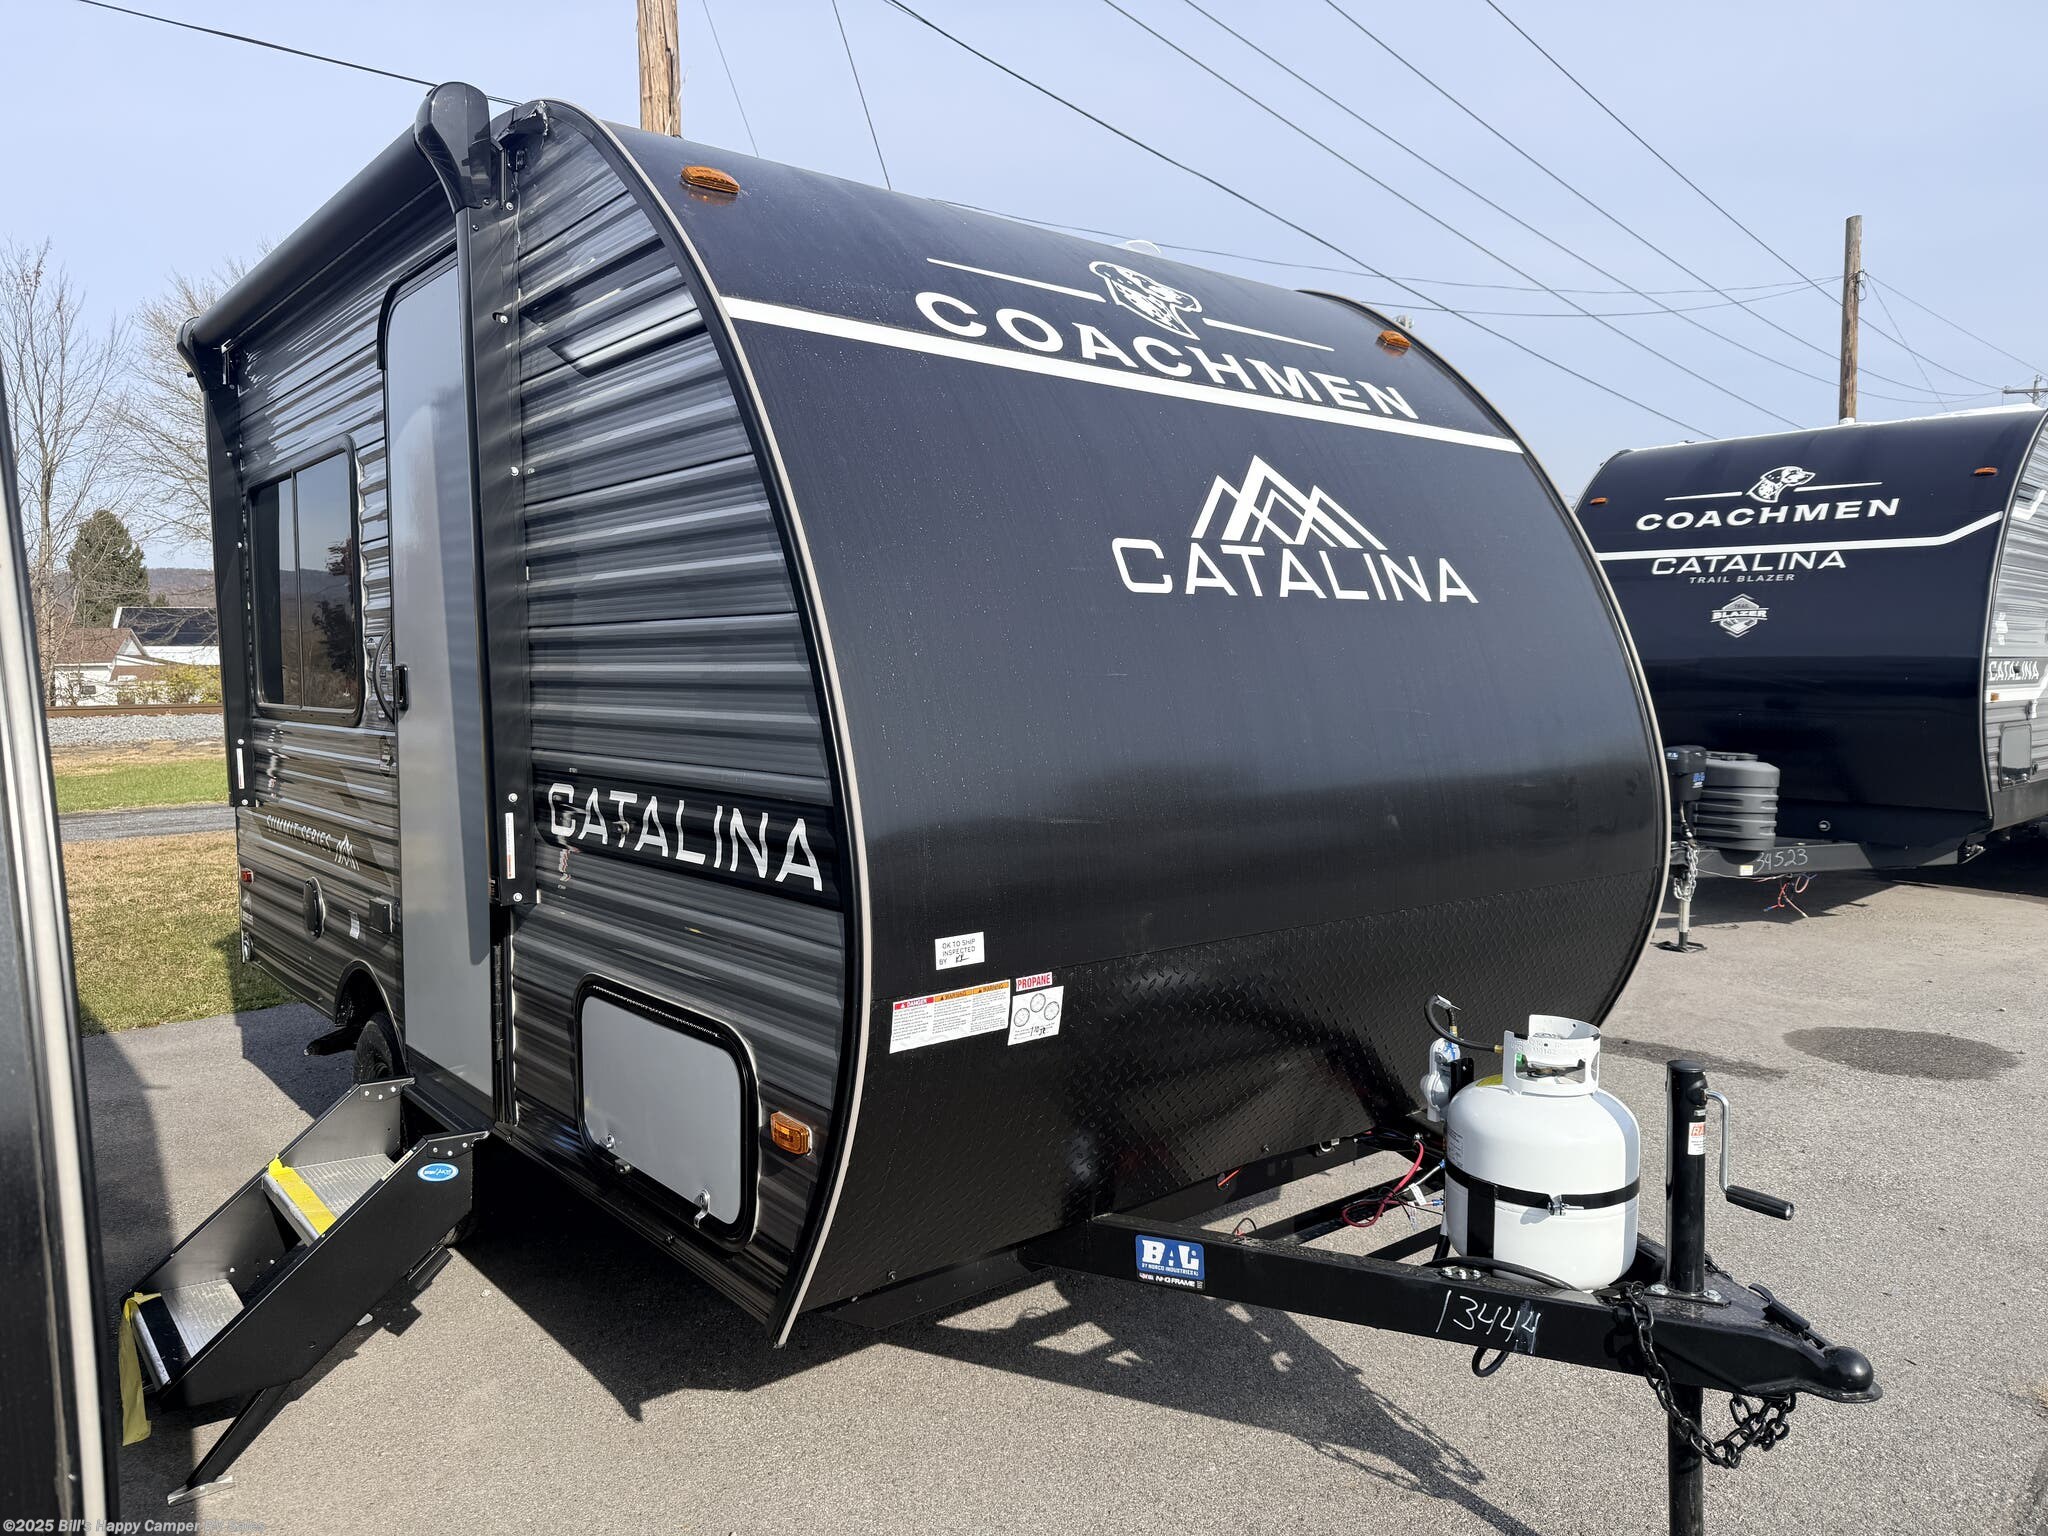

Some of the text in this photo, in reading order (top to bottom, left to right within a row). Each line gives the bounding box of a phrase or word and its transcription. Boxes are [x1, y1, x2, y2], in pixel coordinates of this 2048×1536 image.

[915, 291, 1419, 420] COACHMEN
[1635, 498, 1900, 531] COACHMEN
[1111, 537, 1479, 604] CATALINA
[1651, 551, 1847, 575] CATALINA
[1690, 573, 1796, 584] TRAIL BLAZER
[1712, 610, 1767, 620] BLAZER
[1989, 660, 2039, 681] CATALINA
[301, 825, 331, 853] SERIES
[547, 782, 824, 892] CATALINA
[943, 945, 976, 957] INSPECTED
[1017, 973, 1051, 990] PROPANE
[1142, 1240, 1200, 1270] BAL
